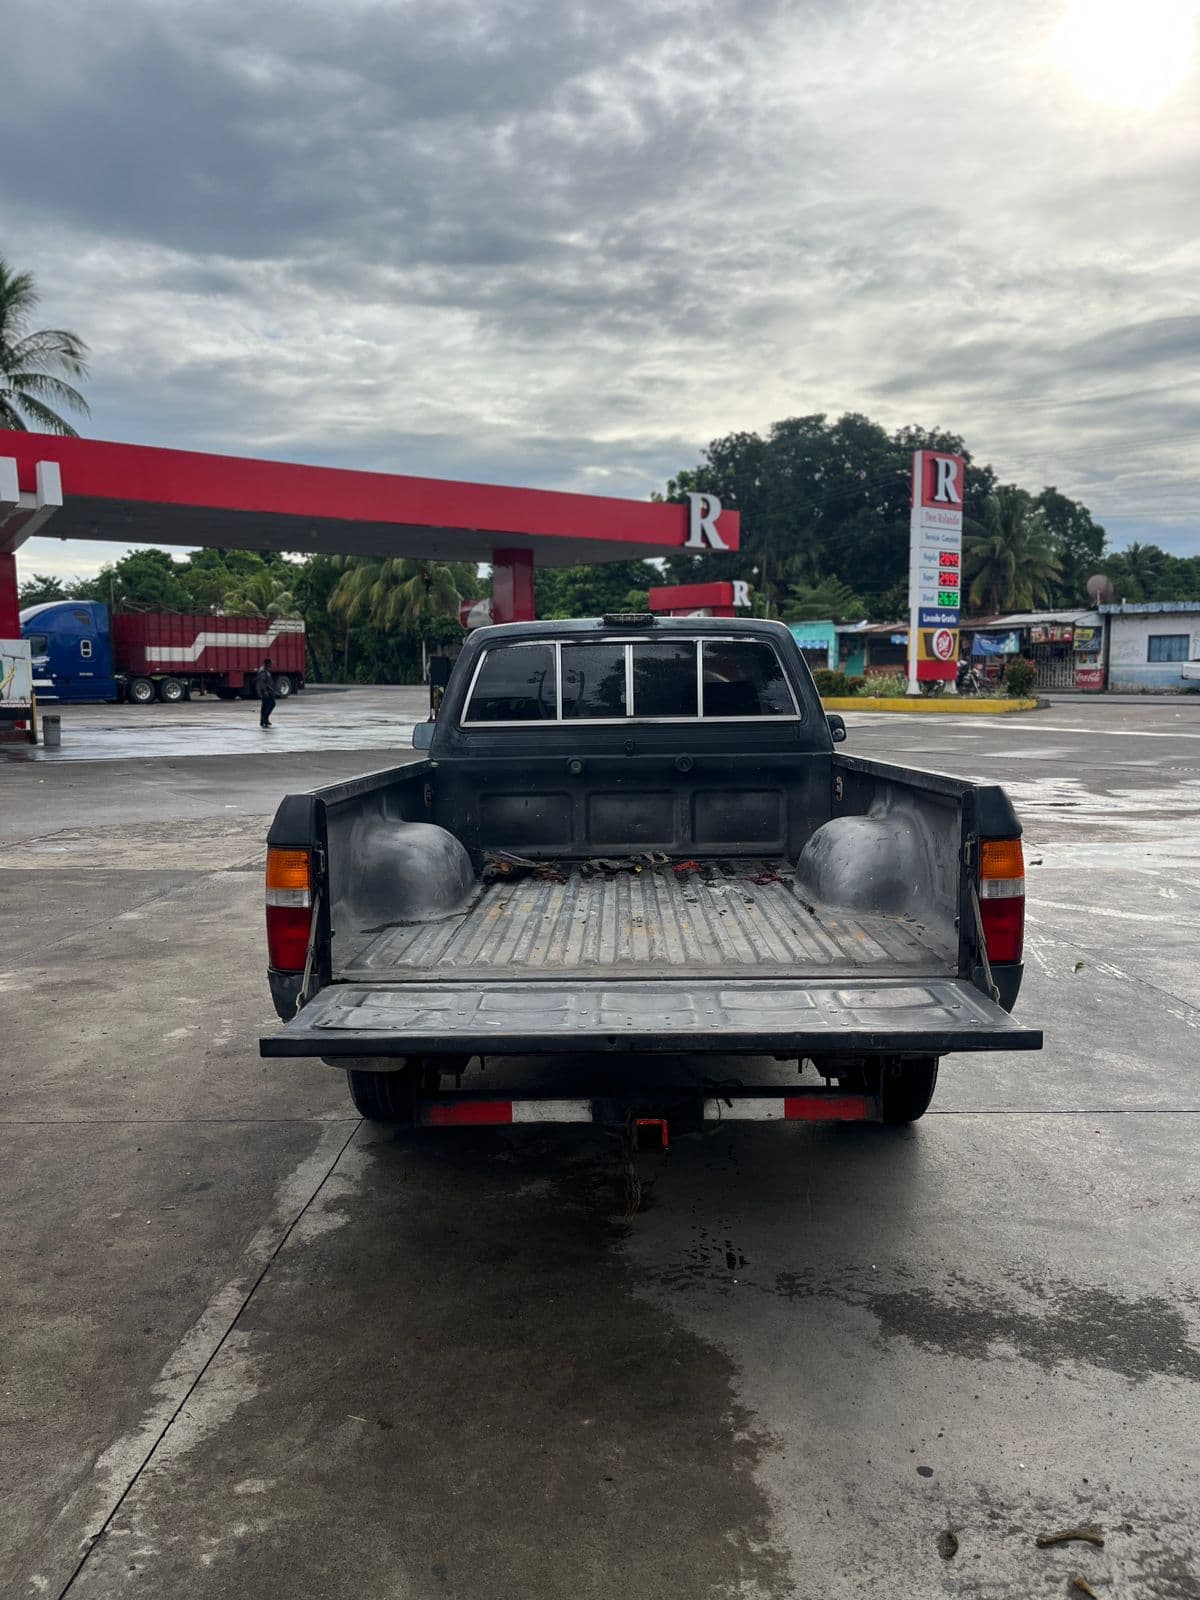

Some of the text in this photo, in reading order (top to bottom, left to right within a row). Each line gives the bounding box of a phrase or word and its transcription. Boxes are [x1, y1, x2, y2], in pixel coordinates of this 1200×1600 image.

[935, 457, 960, 503] R
[684, 492, 729, 550] R
[732, 580, 752, 607] R
